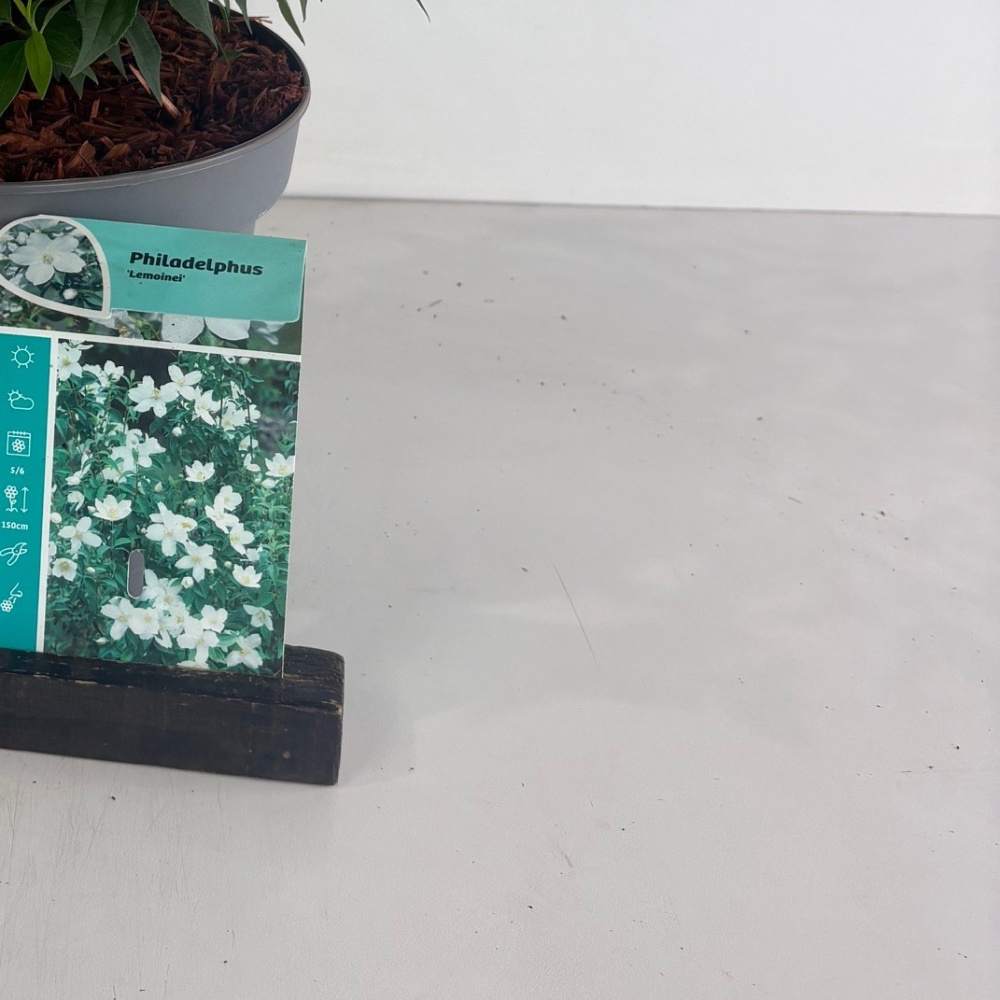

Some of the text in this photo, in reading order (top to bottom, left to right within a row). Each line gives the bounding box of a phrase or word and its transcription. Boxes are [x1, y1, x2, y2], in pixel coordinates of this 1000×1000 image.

[129, 251, 264, 276] Philadelphus
[126, 269, 186, 283] 'Lemoinei'
[10, 466, 25, 475] 5/6
[1, 521, 29, 530] 150cm
